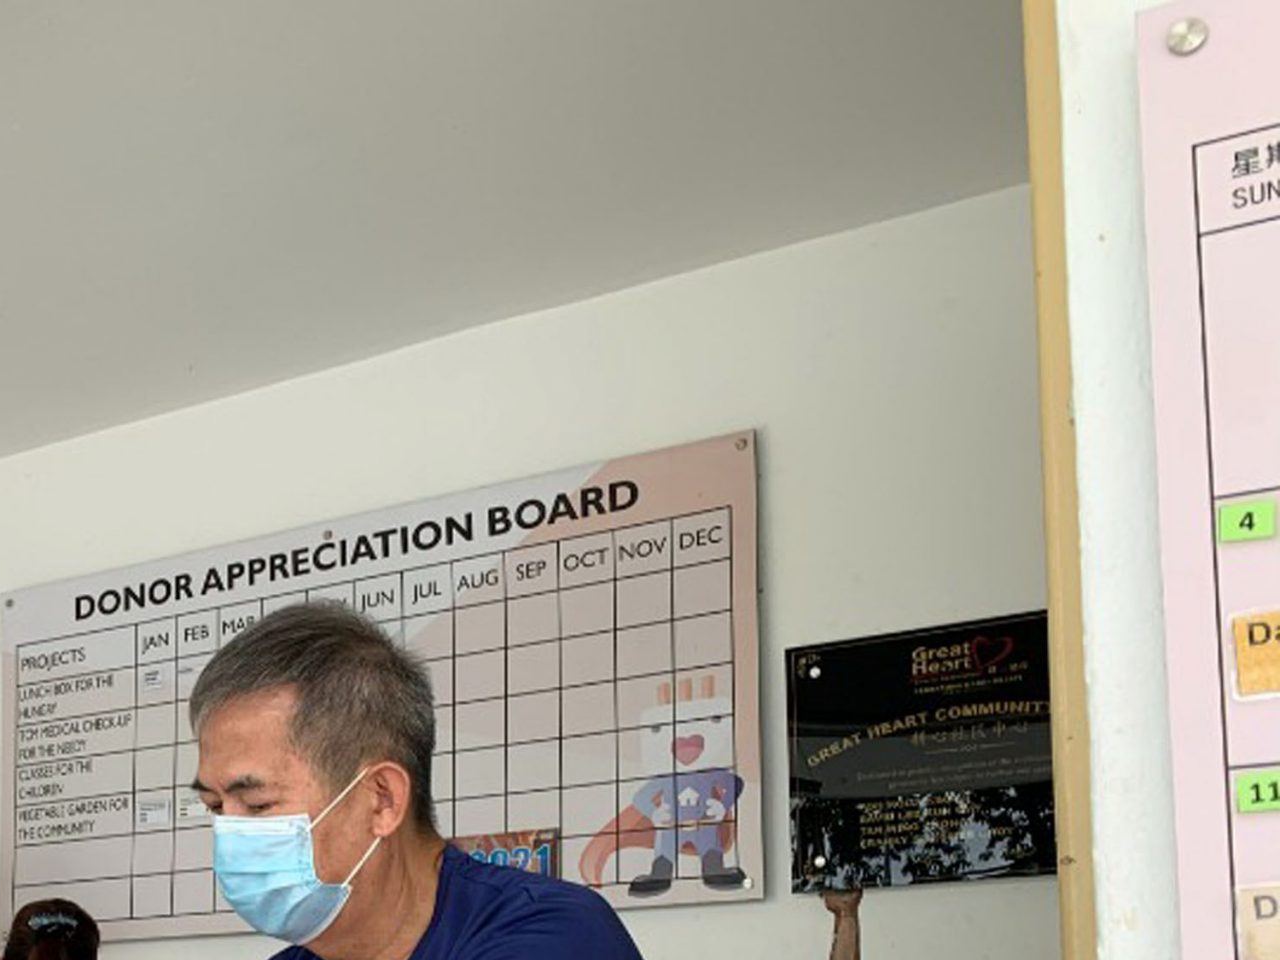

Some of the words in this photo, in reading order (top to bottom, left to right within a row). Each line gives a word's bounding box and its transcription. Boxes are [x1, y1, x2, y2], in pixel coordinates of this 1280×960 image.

[1238, 511, 1256, 531] 4
[74, 573, 194, 621] DONOR
[200, 512, 473, 596] APPRECIATION
[487, 479, 640, 538] BOARD
[142, 631, 170, 655] JAN
[183, 623, 210, 643] FEB
[360, 587, 395, 614] JUN
[412, 580, 442, 604] JUL
[456, 568, 499, 593] AUG
[515, 559, 547, 582] SEP
[563, 547, 609, 573] OCT
[619, 536, 668, 562] NOV
[678, 525, 724, 551] DEC
[20, 646, 86, 672] PROJECTS
[911, 641, 972, 663] Great
[911, 655, 972, 676] Heart
[19, 685, 52, 702] LUNCH
[54, 682, 73, 696] BOX
[75, 678, 94, 693] FOR
[96, 674, 114, 689] THE
[19, 702, 58, 720] HUNGRY
[40, 721, 80, 739] MEDICAL
[807, 731, 862, 768] GREAT
[870, 713, 927, 740] HEART
[19, 745, 36, 760] FOR
[38, 743, 55, 757] THE
[1250, 782, 1280, 804] 11
[67, 799, 107, 817] GARDEN
[109, 796, 129, 812] FOR
[18, 827, 35, 841] THE
[37, 819, 96, 839] COMMUNITY
